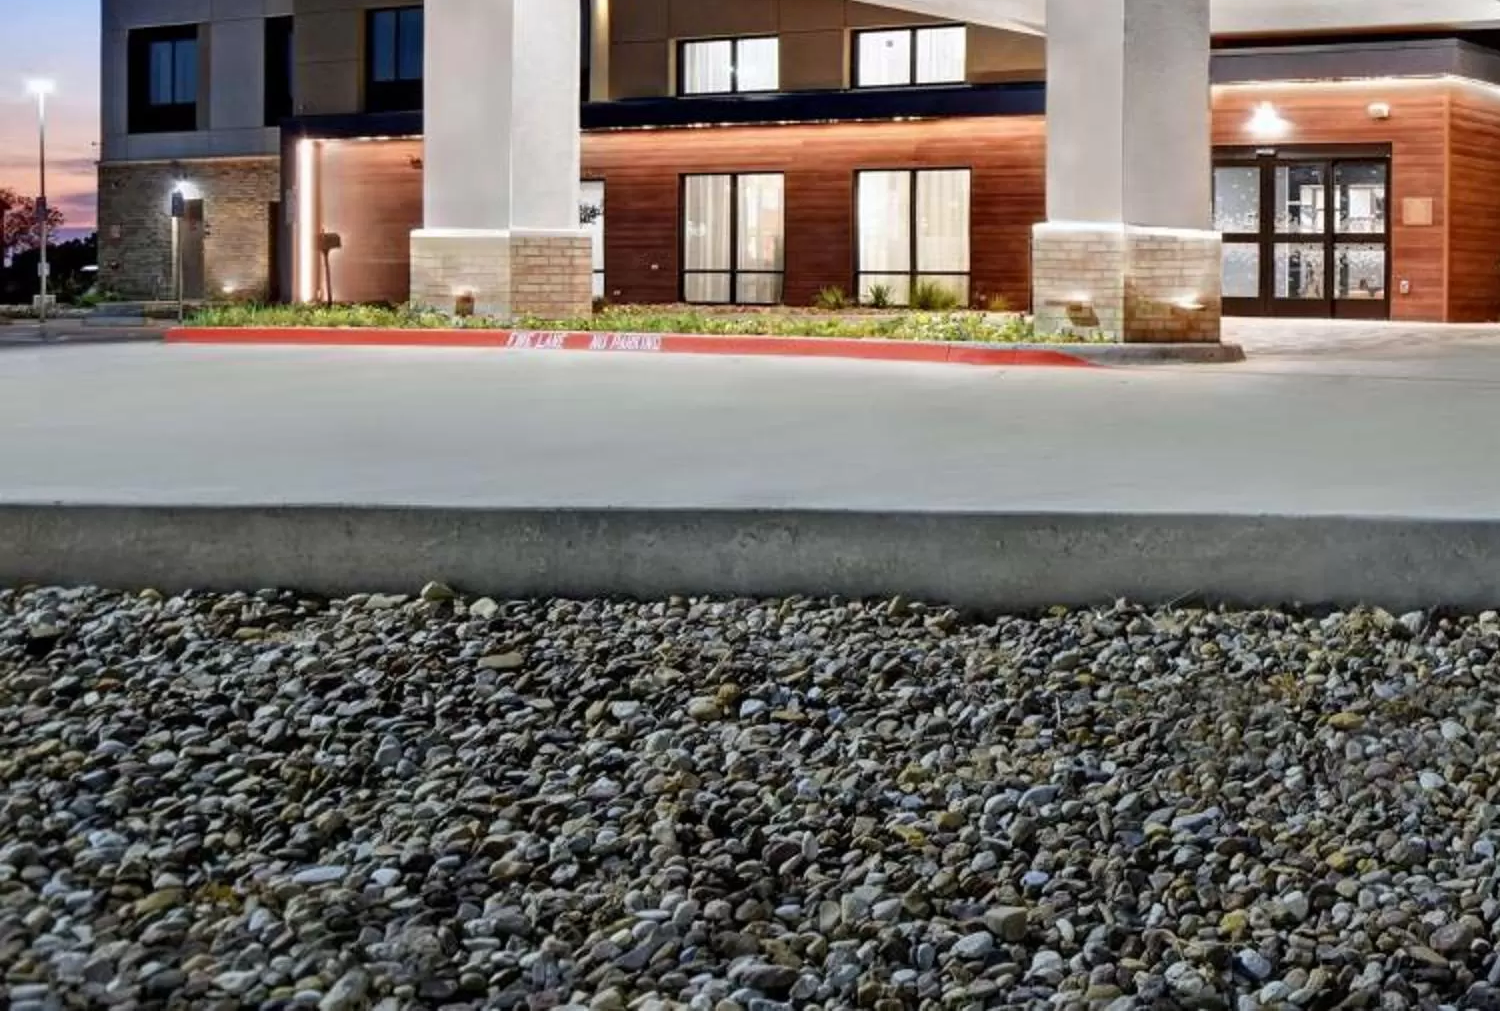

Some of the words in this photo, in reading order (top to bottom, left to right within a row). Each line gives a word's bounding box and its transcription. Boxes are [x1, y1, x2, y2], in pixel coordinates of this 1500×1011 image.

[534, 332, 567, 349] LANE
[589, 334, 608, 350] NO
[610, 334, 662, 351] PARKING
